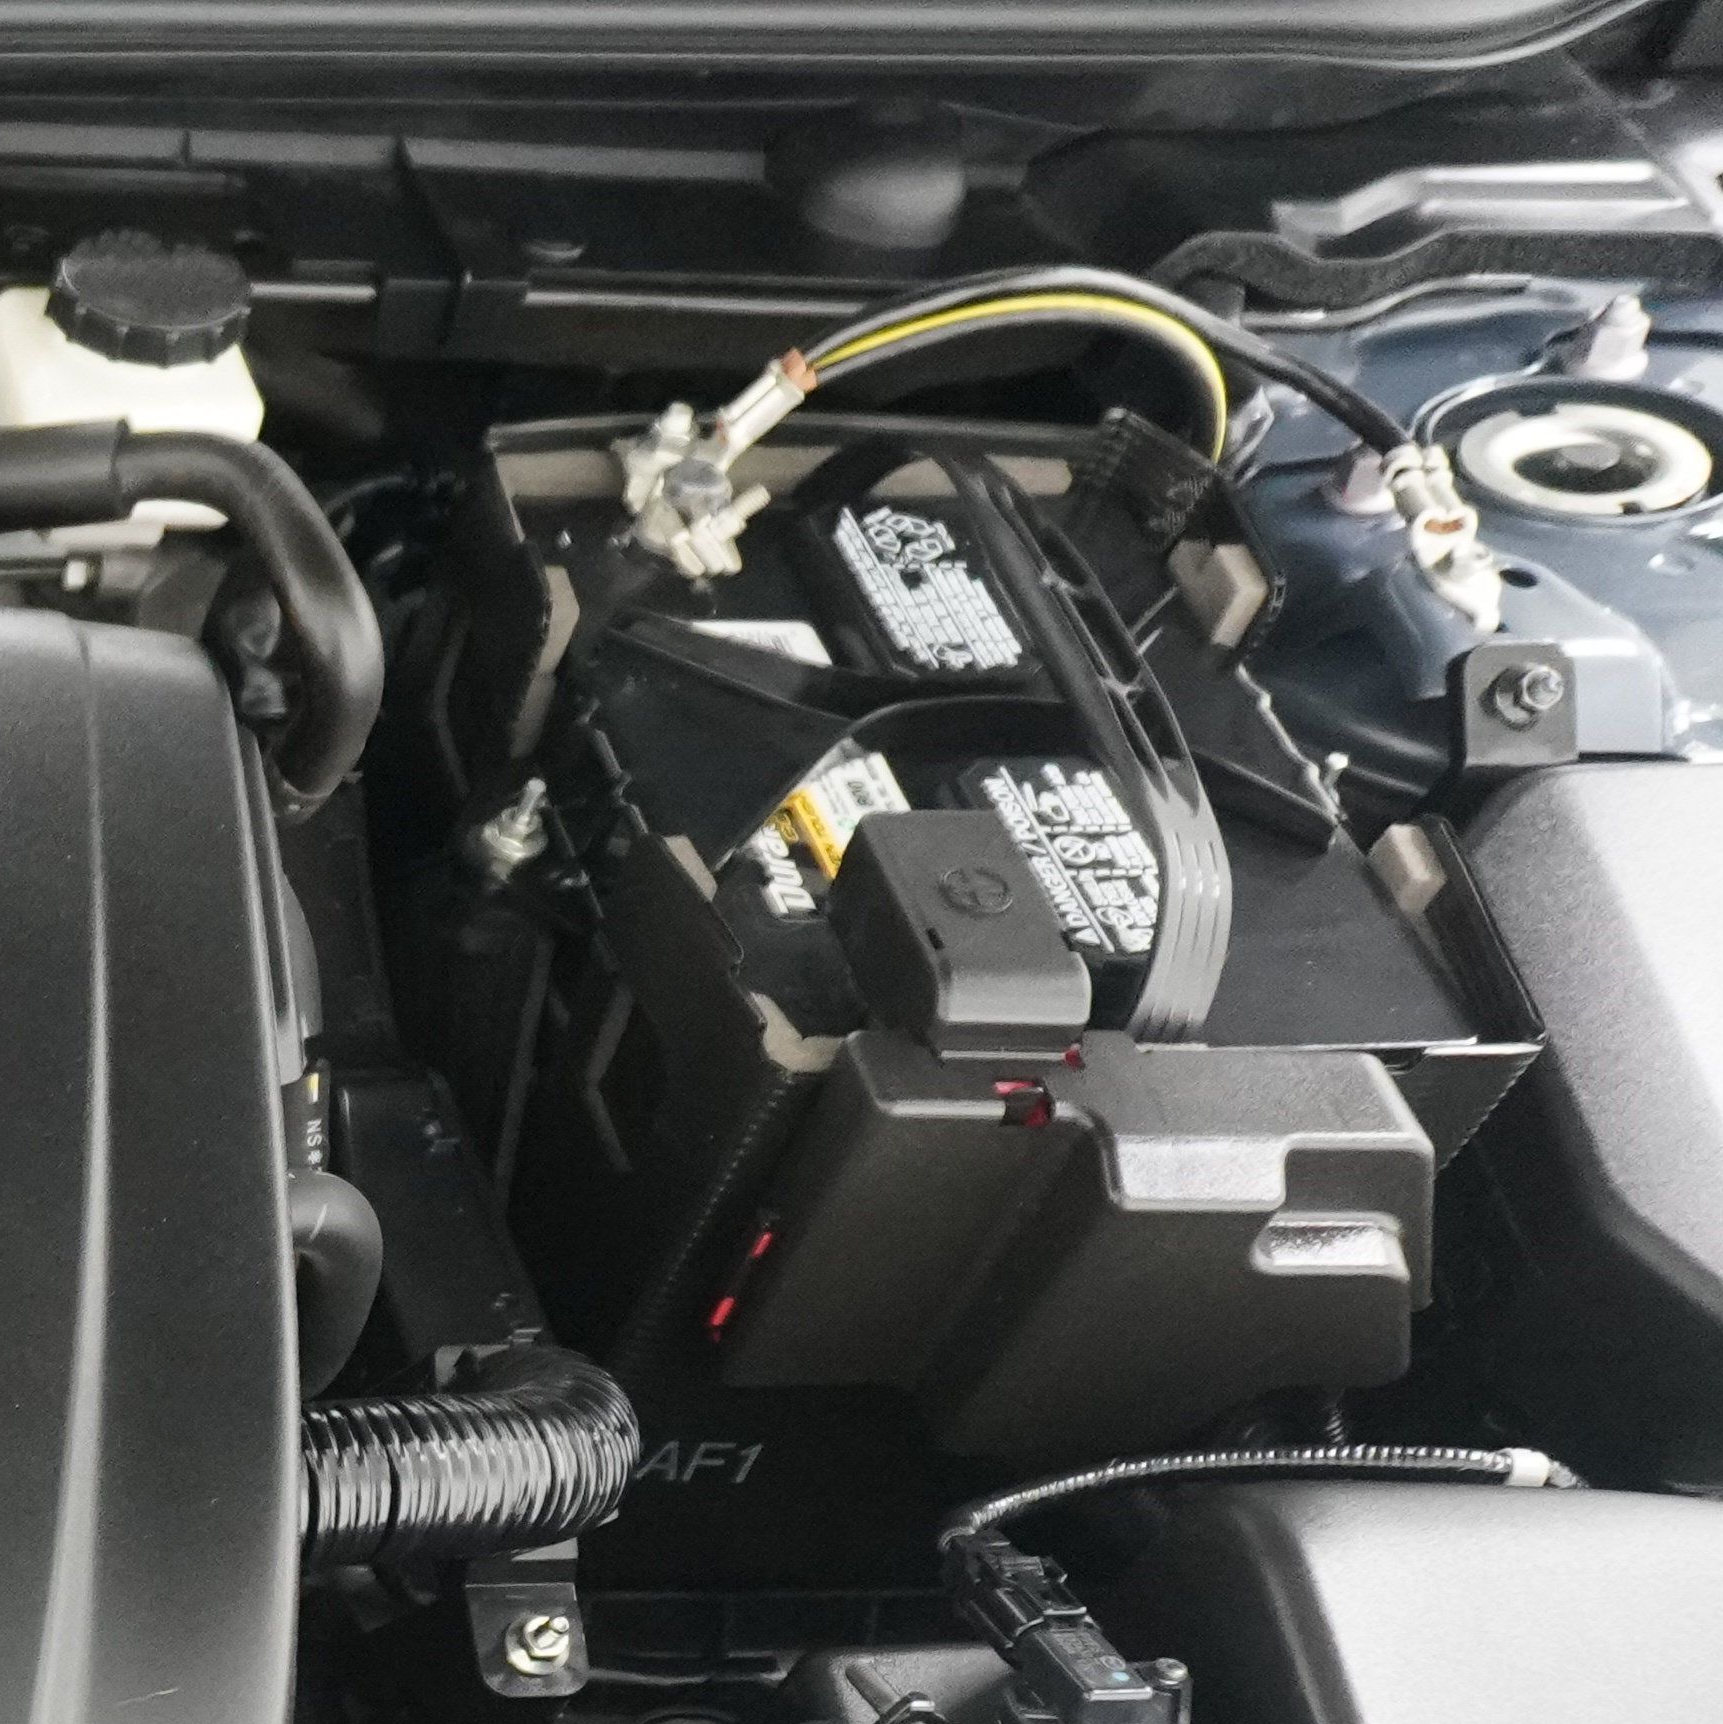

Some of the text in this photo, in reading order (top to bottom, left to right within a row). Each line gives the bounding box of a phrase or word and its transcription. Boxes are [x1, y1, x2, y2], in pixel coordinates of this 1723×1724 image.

[982, 777, 1039, 840] POISON
[1030, 855, 1091, 928] DANGER
[635, 1440, 764, 1484] AF1
